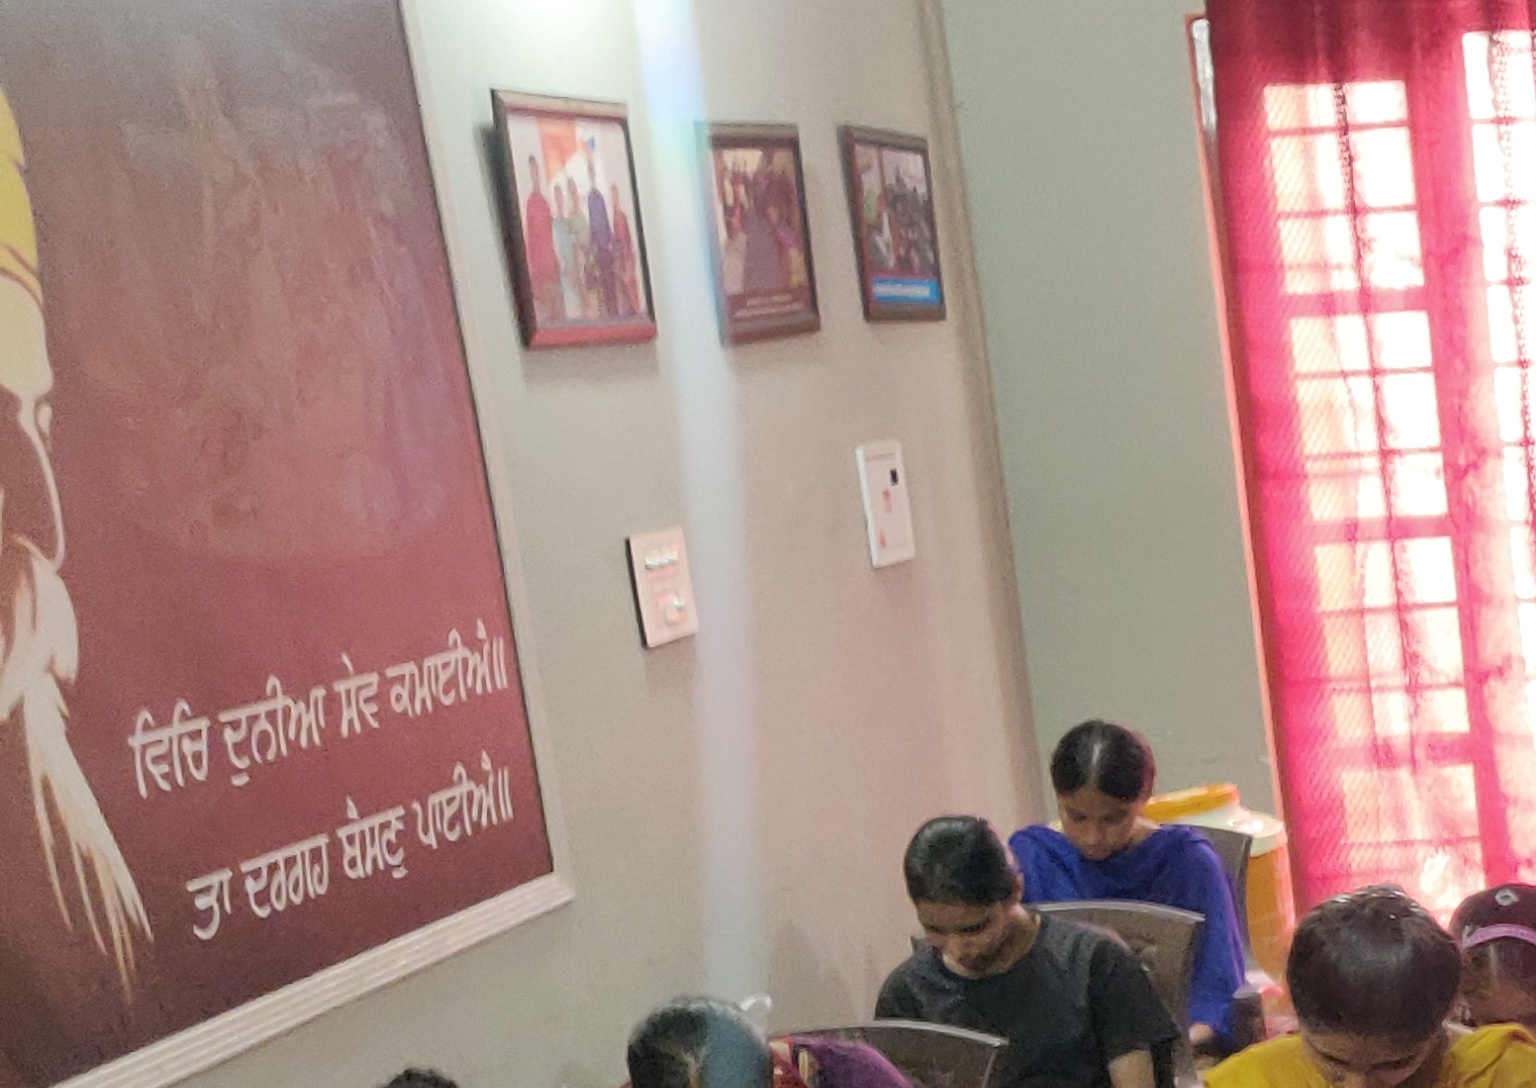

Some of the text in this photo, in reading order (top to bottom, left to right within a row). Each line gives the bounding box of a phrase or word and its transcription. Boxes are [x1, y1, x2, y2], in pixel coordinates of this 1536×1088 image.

[127, 697, 211, 798] ਵਿਚਿ
[219, 674, 326, 787] ਦੁਨੀਆ
[333, 652, 380, 738] ਸੇਵ
[186, 867, 233, 942] ਤਾ
[240, 834, 329, 919] ਦਰਗਹ
